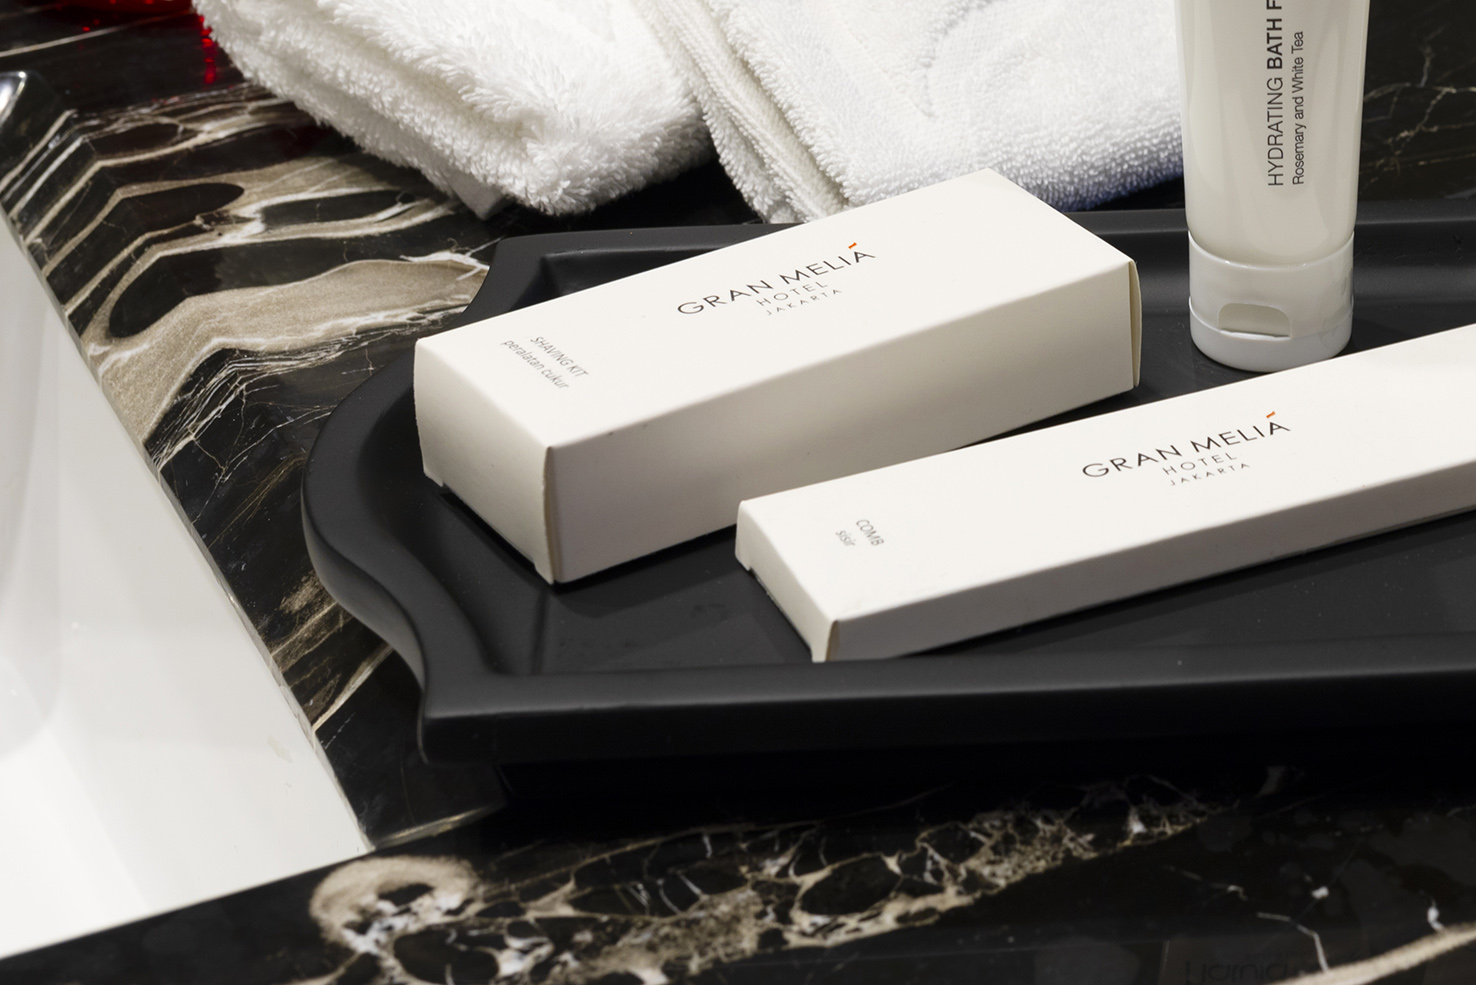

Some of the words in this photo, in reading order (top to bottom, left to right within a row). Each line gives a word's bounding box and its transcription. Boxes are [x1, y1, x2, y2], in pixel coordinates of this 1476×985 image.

[1266, 18, 1282, 70] BATH
[1291, 31, 1304, 55] Tea
[1291, 57, 1304, 94] White
[1291, 96, 1304, 120] and
[1266, 77, 1284, 186] HYDRATING
[1292, 123, 1306, 185] Rosemary
[677, 279, 773, 314] GRAN
[779, 242, 876, 284] MELIÁ
[756, 281, 828, 306] HOTEL
[766, 289, 842, 316] JAKARTA
[500, 340, 545, 370] peralatan
[541, 369, 569, 388] cukur
[530, 336, 574, 366] SHAVING
[566, 364, 589, 377] KIT
[1082, 444, 1182, 478] GRAN
[1190, 411, 1291, 453] MELIÁ
[1162, 452, 1238, 476] HOTEL
[1170, 463, 1250, 486] JAKARTA
[856, 519, 884, 546] COMB
